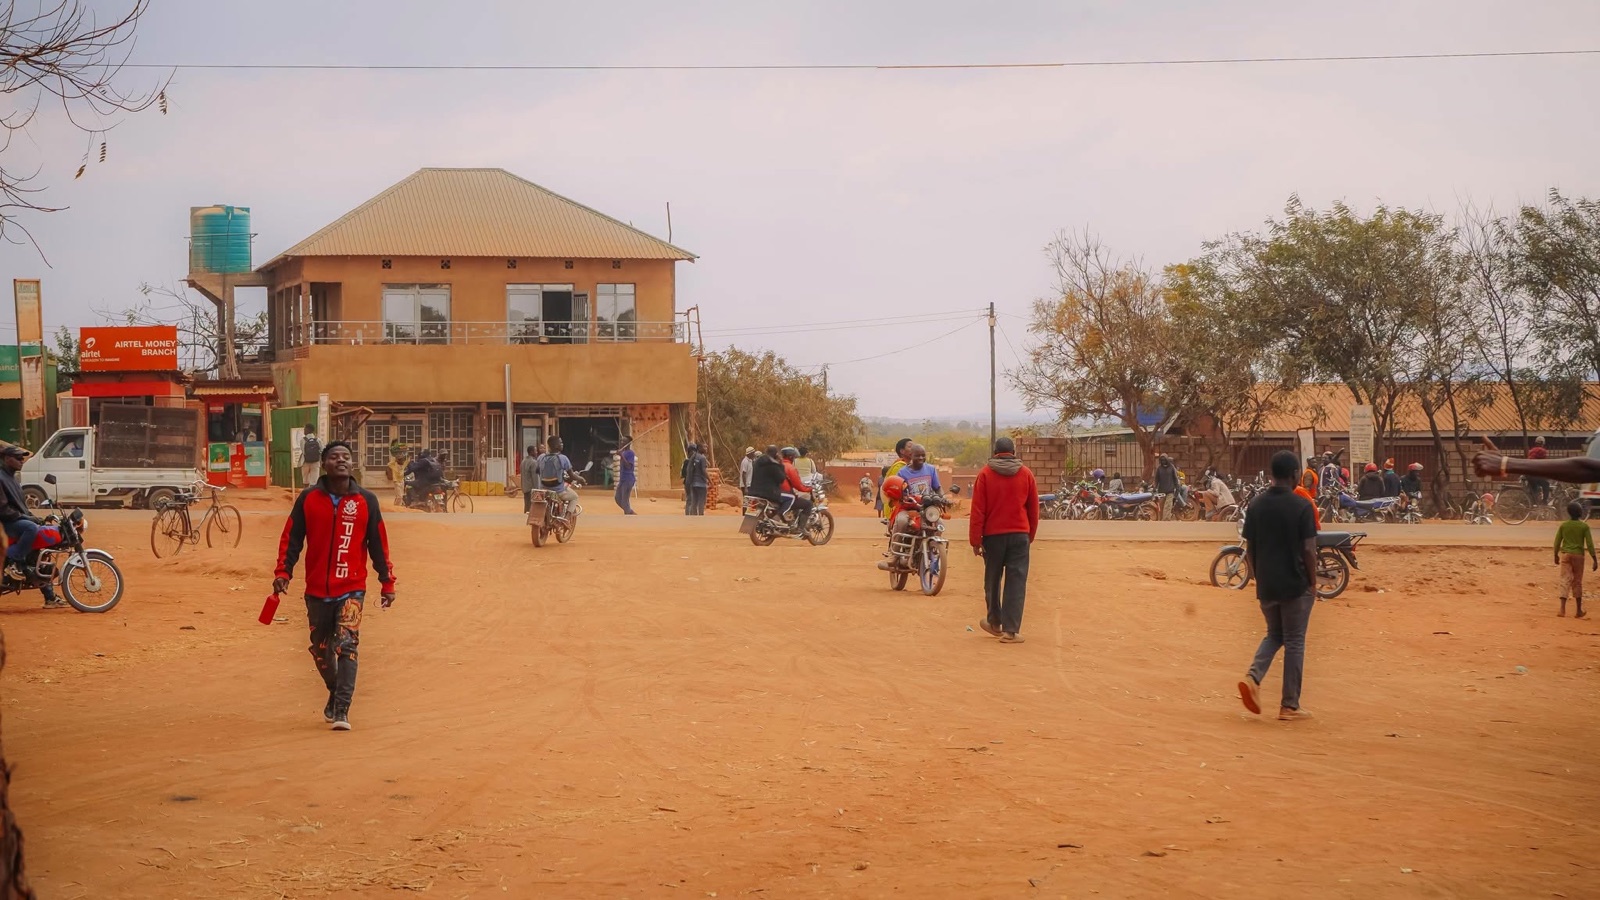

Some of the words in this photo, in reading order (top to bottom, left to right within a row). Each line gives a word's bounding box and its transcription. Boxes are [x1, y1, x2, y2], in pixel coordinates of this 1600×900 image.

[81, 350, 101, 358] airtel
[141, 348, 176, 356] BRANCH
[335, 521, 354, 578] PRL15
